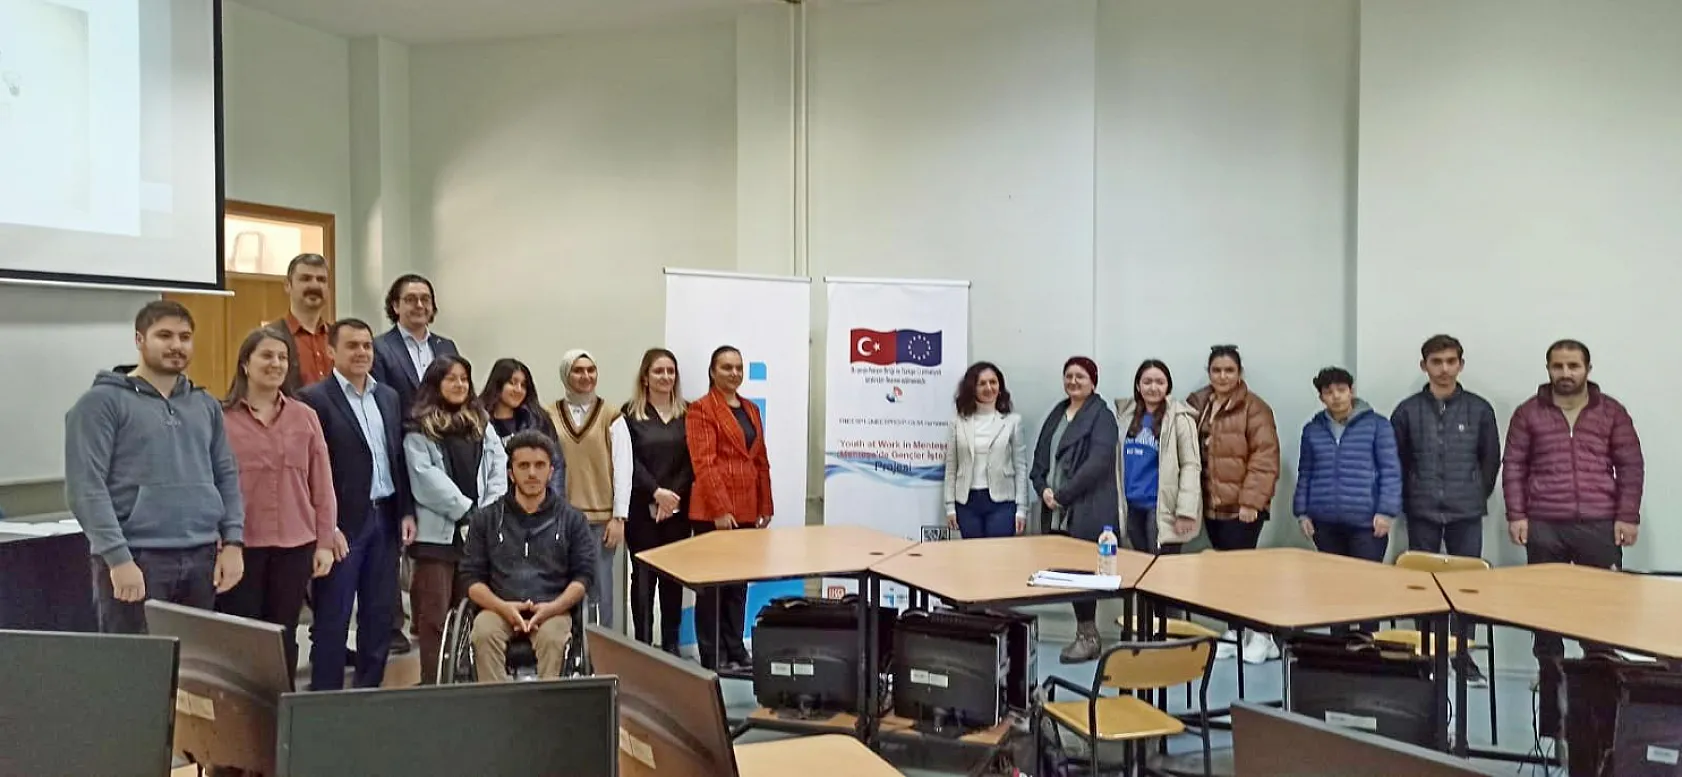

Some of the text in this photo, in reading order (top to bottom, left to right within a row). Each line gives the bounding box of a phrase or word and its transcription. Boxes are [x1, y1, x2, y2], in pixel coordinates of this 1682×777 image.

[841, 439, 865, 448] Youth
[868, 440, 875, 448] at
[878, 439, 900, 448] Work
[903, 440, 911, 448] in
